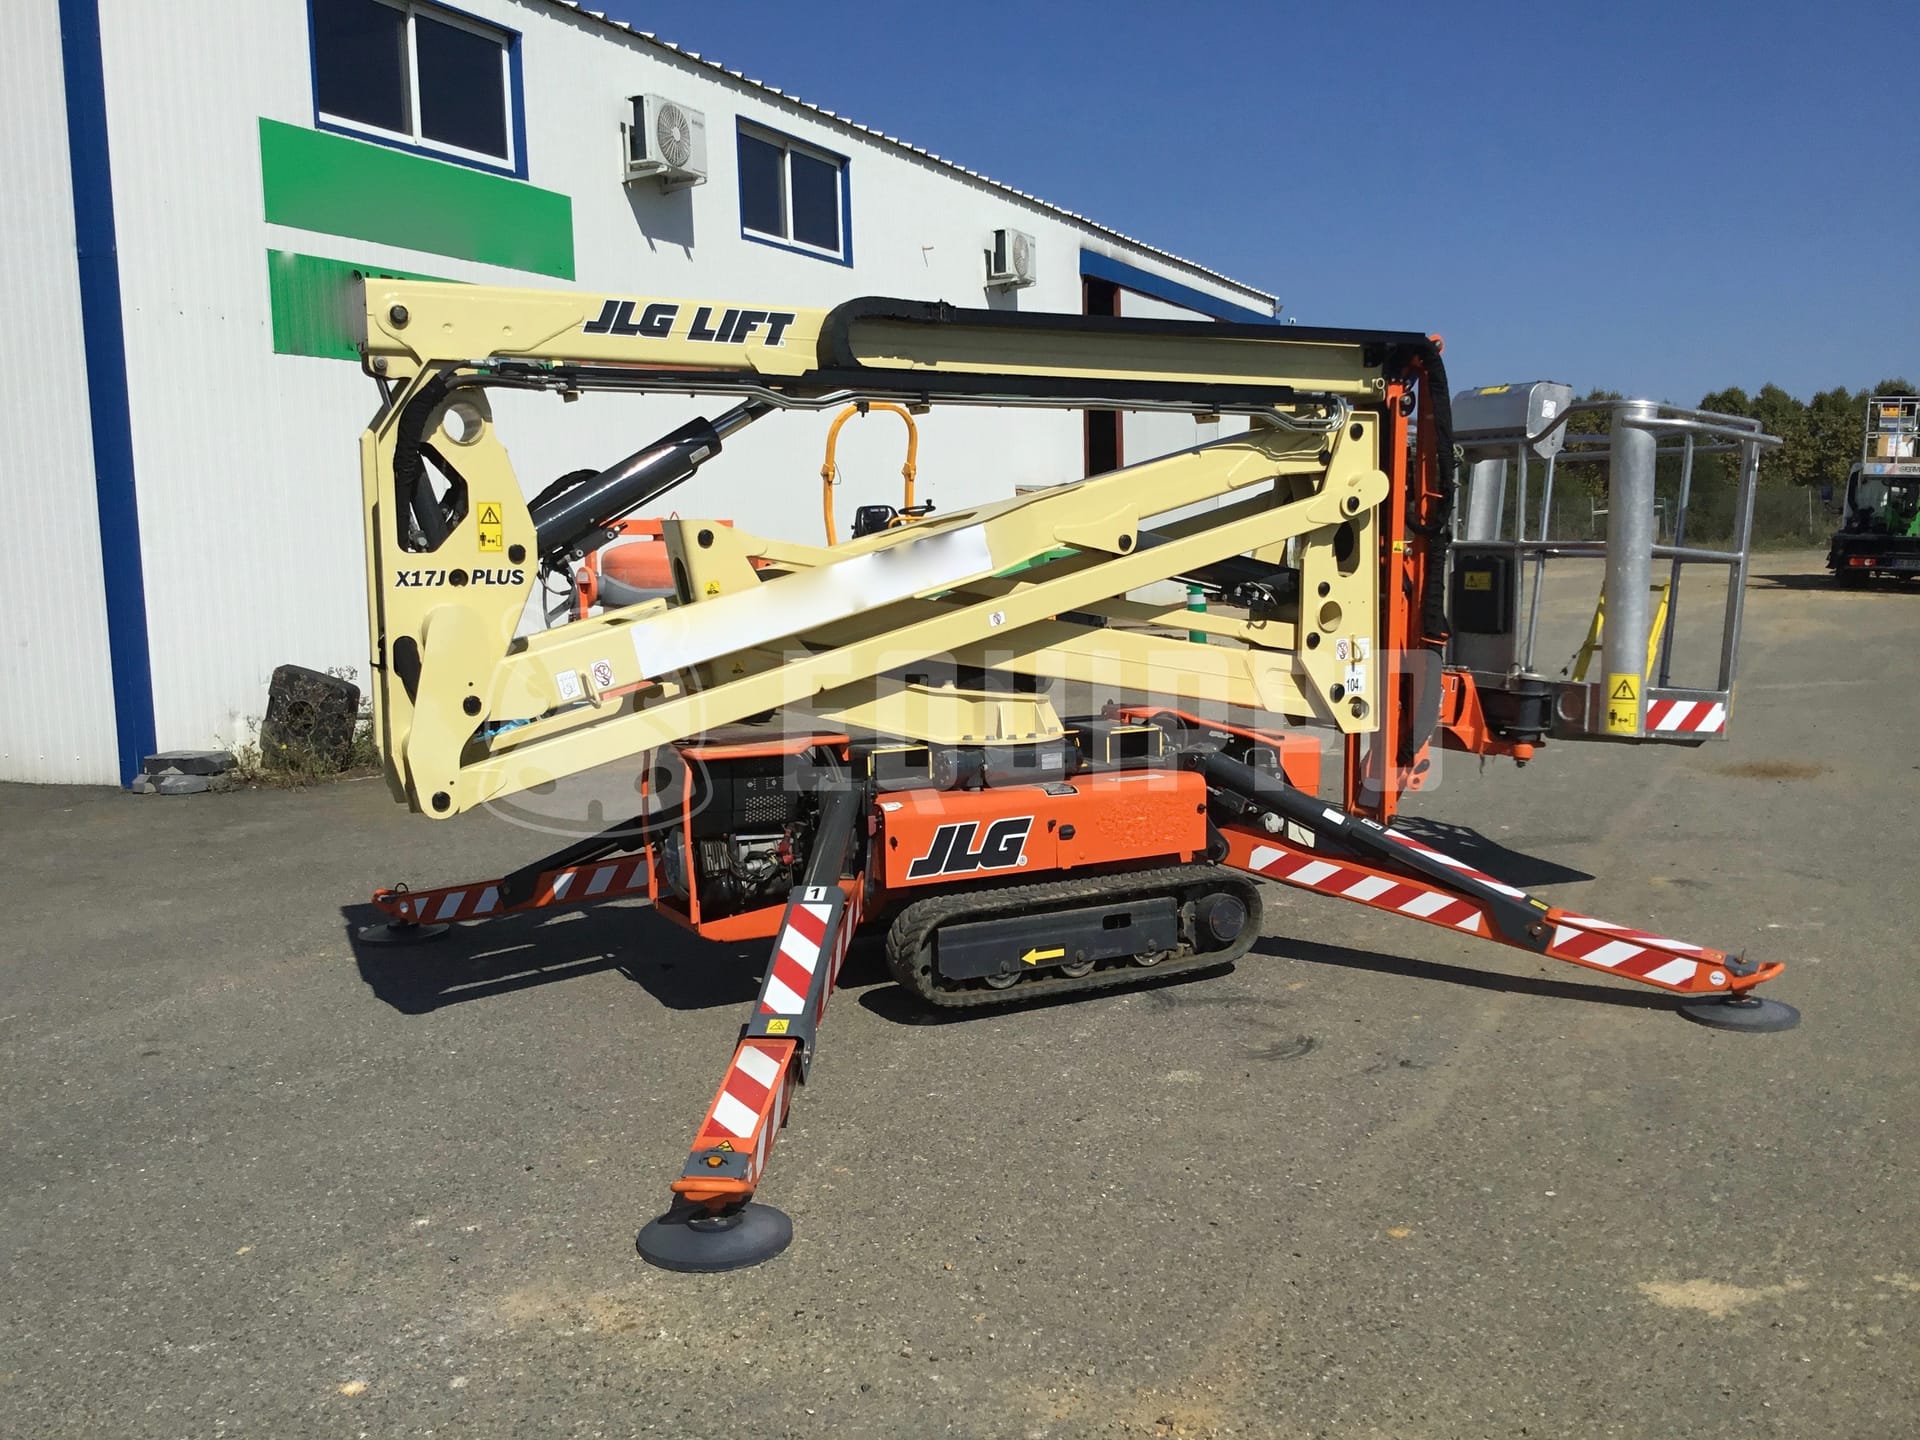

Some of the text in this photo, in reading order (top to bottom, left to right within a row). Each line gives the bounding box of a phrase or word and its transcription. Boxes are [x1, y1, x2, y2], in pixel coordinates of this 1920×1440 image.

[583, 299, 797, 347] JLG LIFT
[395, 569, 525, 587] X17J PLUS
[1346, 677, 1360, 692] 104
[906, 815, 1035, 880] JLG
[810, 887, 821, 900] 1
